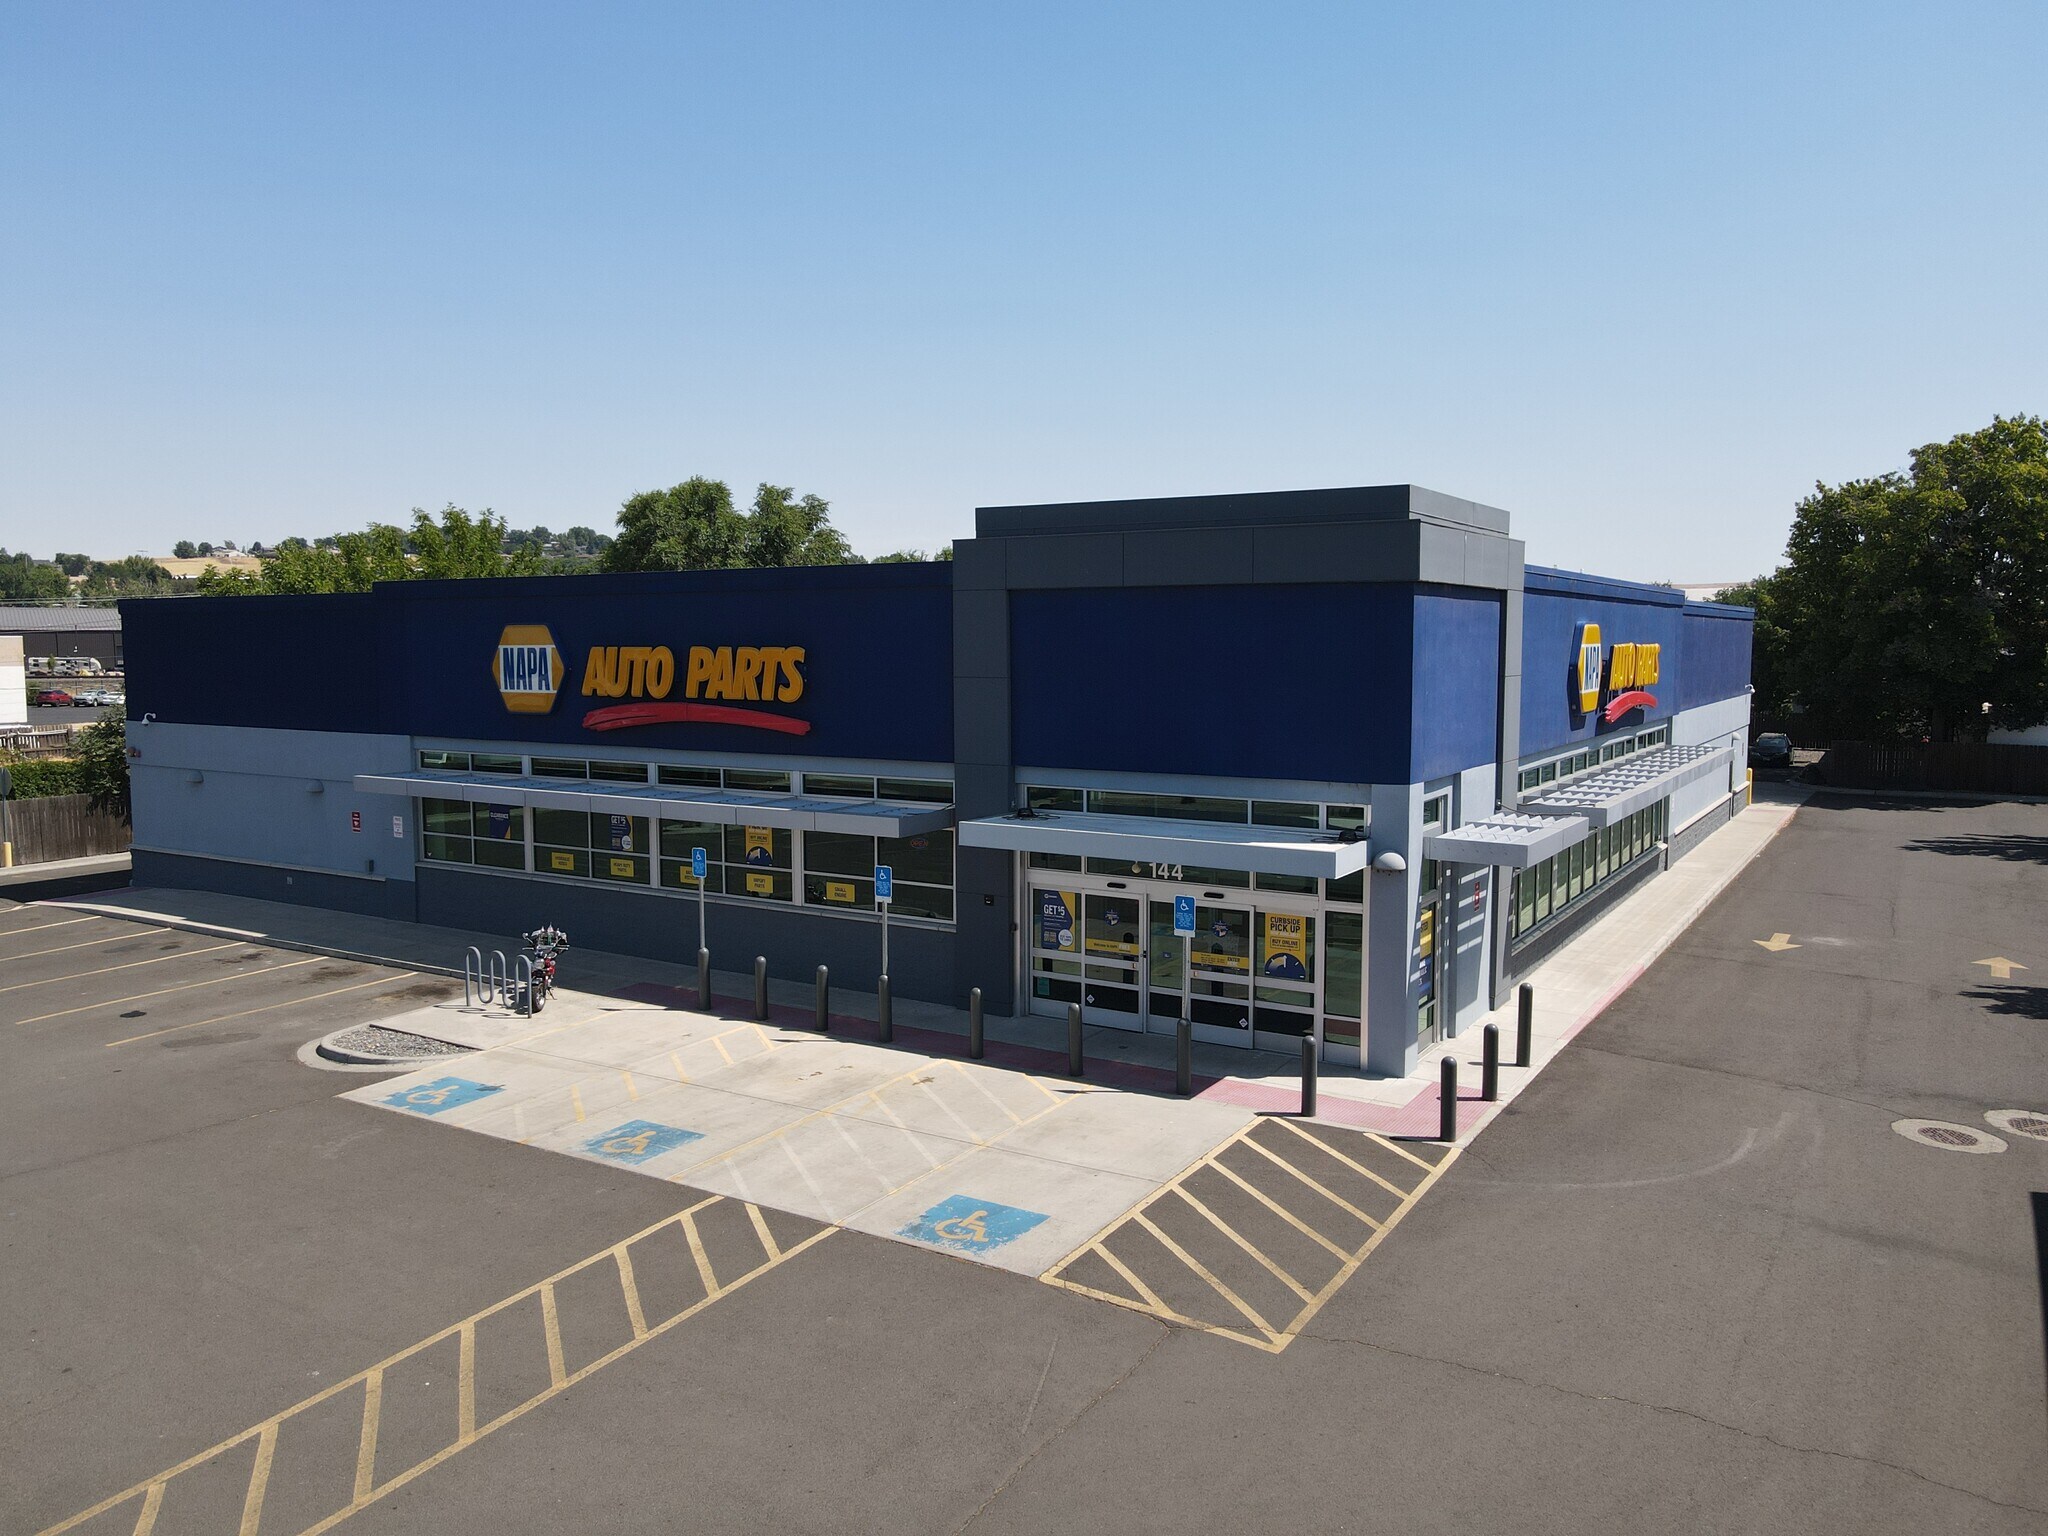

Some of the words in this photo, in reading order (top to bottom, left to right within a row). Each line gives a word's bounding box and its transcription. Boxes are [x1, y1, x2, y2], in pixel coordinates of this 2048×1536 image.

[503, 647, 550, 691] NAPA
[581, 645, 675, 700] AUTO
[685, 646, 806, 703] PARTS
[1585, 646, 1600, 690] NAPA
[1609, 642, 1636, 691] AUTO
[611, 816, 620, 824] GET
[1149, 862, 1183, 881] 144
[1043, 904, 1057, 915] GET
[1058, 906, 1065, 916] $5
[1270, 916, 1301, 925] CURBSIDE
[1270, 923, 1288, 932] PICK
[1290, 925, 1301, 933] UP
